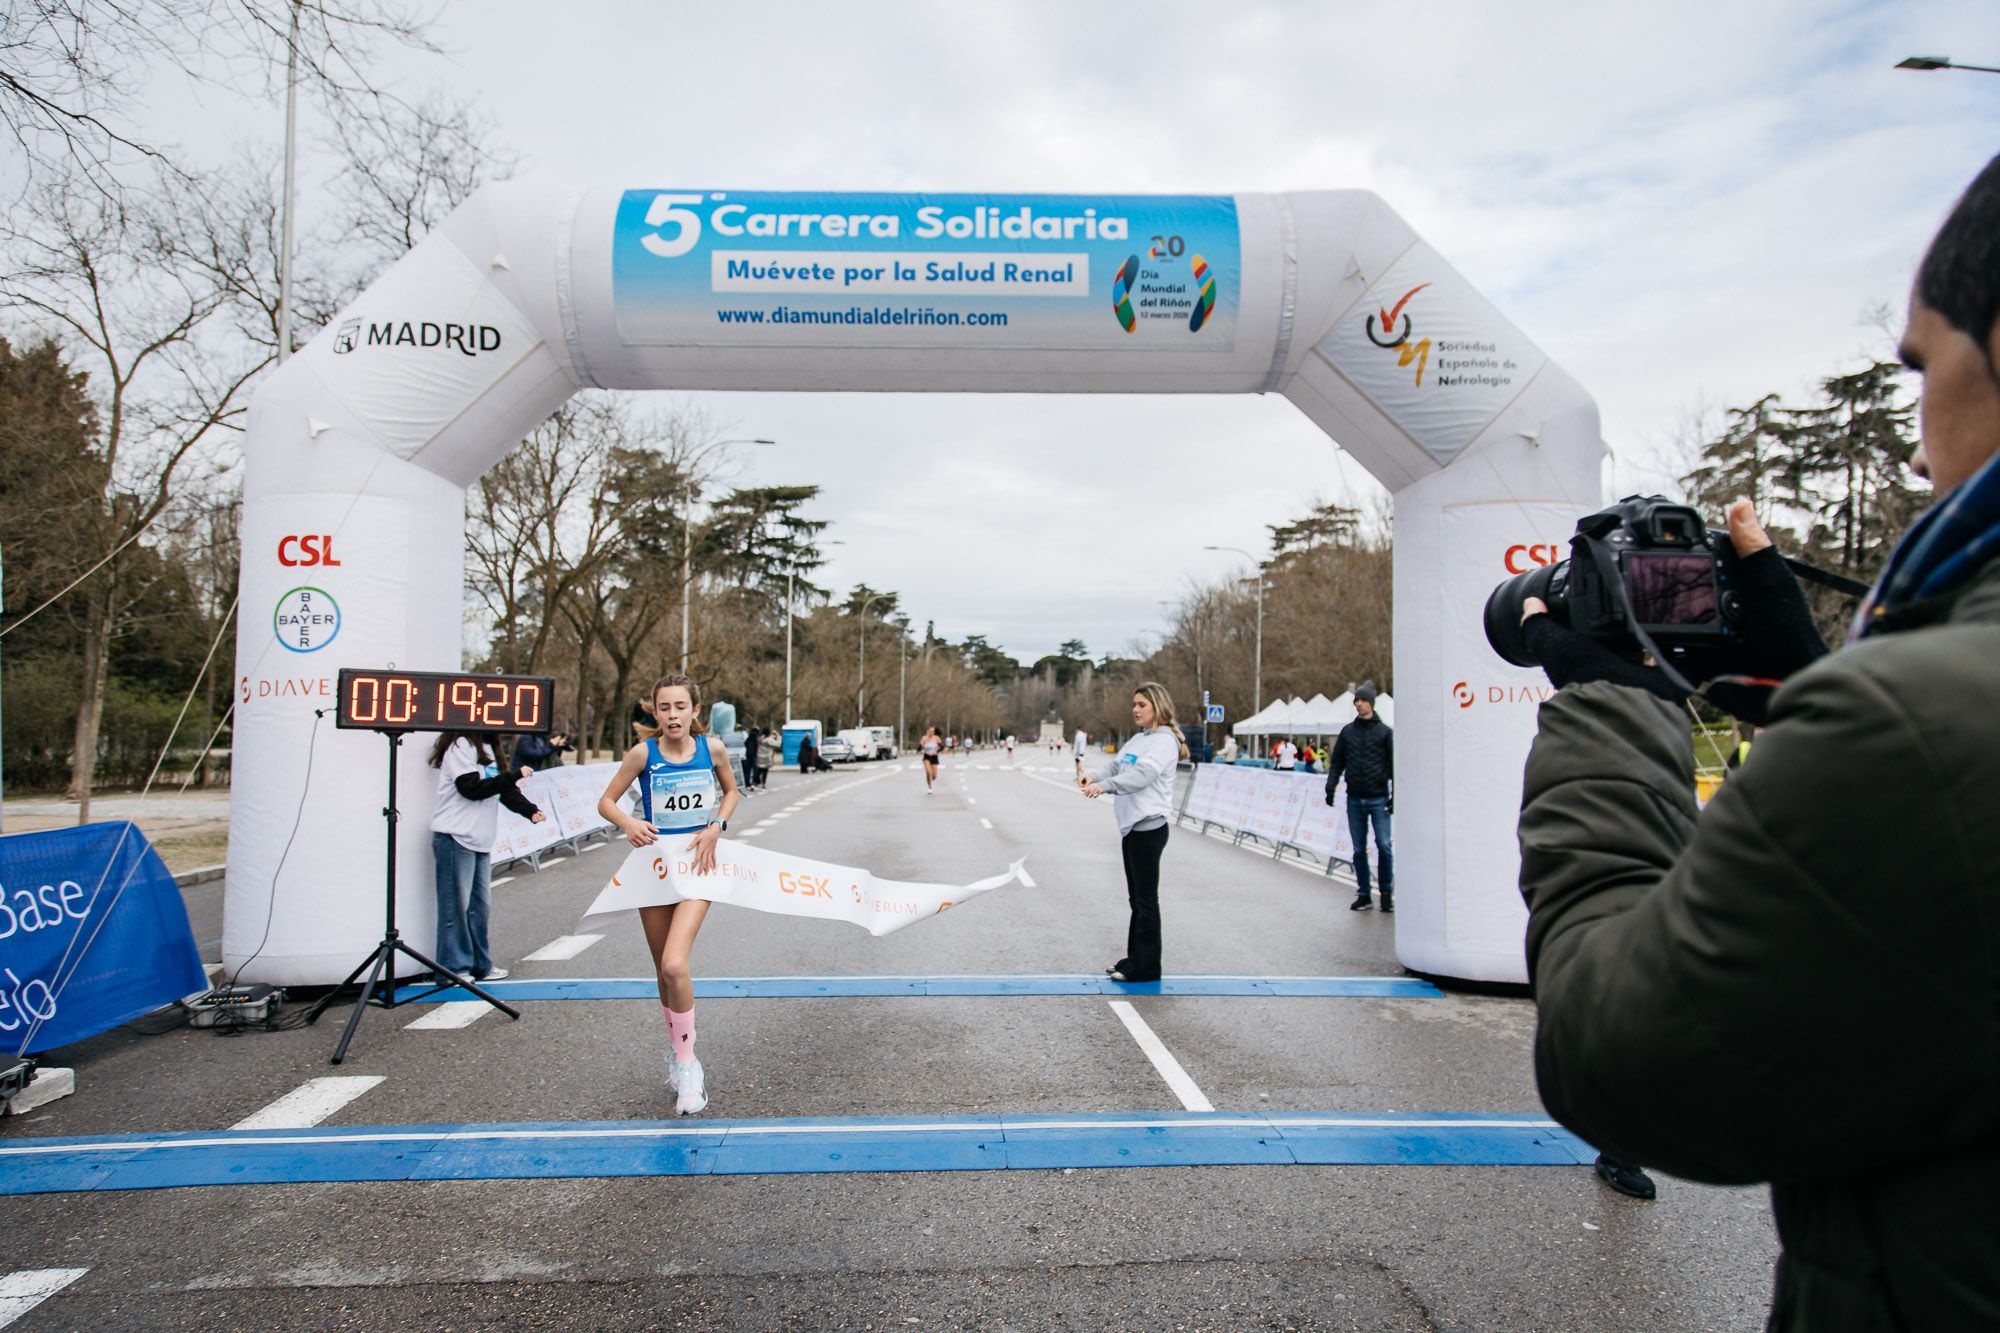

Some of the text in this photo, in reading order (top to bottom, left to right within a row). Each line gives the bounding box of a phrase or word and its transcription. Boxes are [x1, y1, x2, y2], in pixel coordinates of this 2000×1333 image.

[711, 203, 899, 238] Carrera
[914, 206, 1128, 240] Solidaria
[1148, 235, 1185, 257] 20
[727, 260, 1073, 286] Muévete por la Salud Renal
[1141, 284, 1186, 293] Mundial
[1140, 297, 1191, 308] del Riñón
[717, 306, 1008, 326] www.diamundialdelriñon.com
[368, 322, 501, 356] MADRID
[1438, 340, 1496, 352] Sociedad
[1438, 358, 1518, 371] Española de
[277, 535, 341, 567] CSL
[279, 615, 334, 625] BAYER
[300, 592, 311, 647] BAYER
[351, 677, 540, 726] 00:19:20
[1489, 686, 1555, 703] DIAV
[664, 793, 703, 811] 402
[778, 871, 833, 900] GSK
